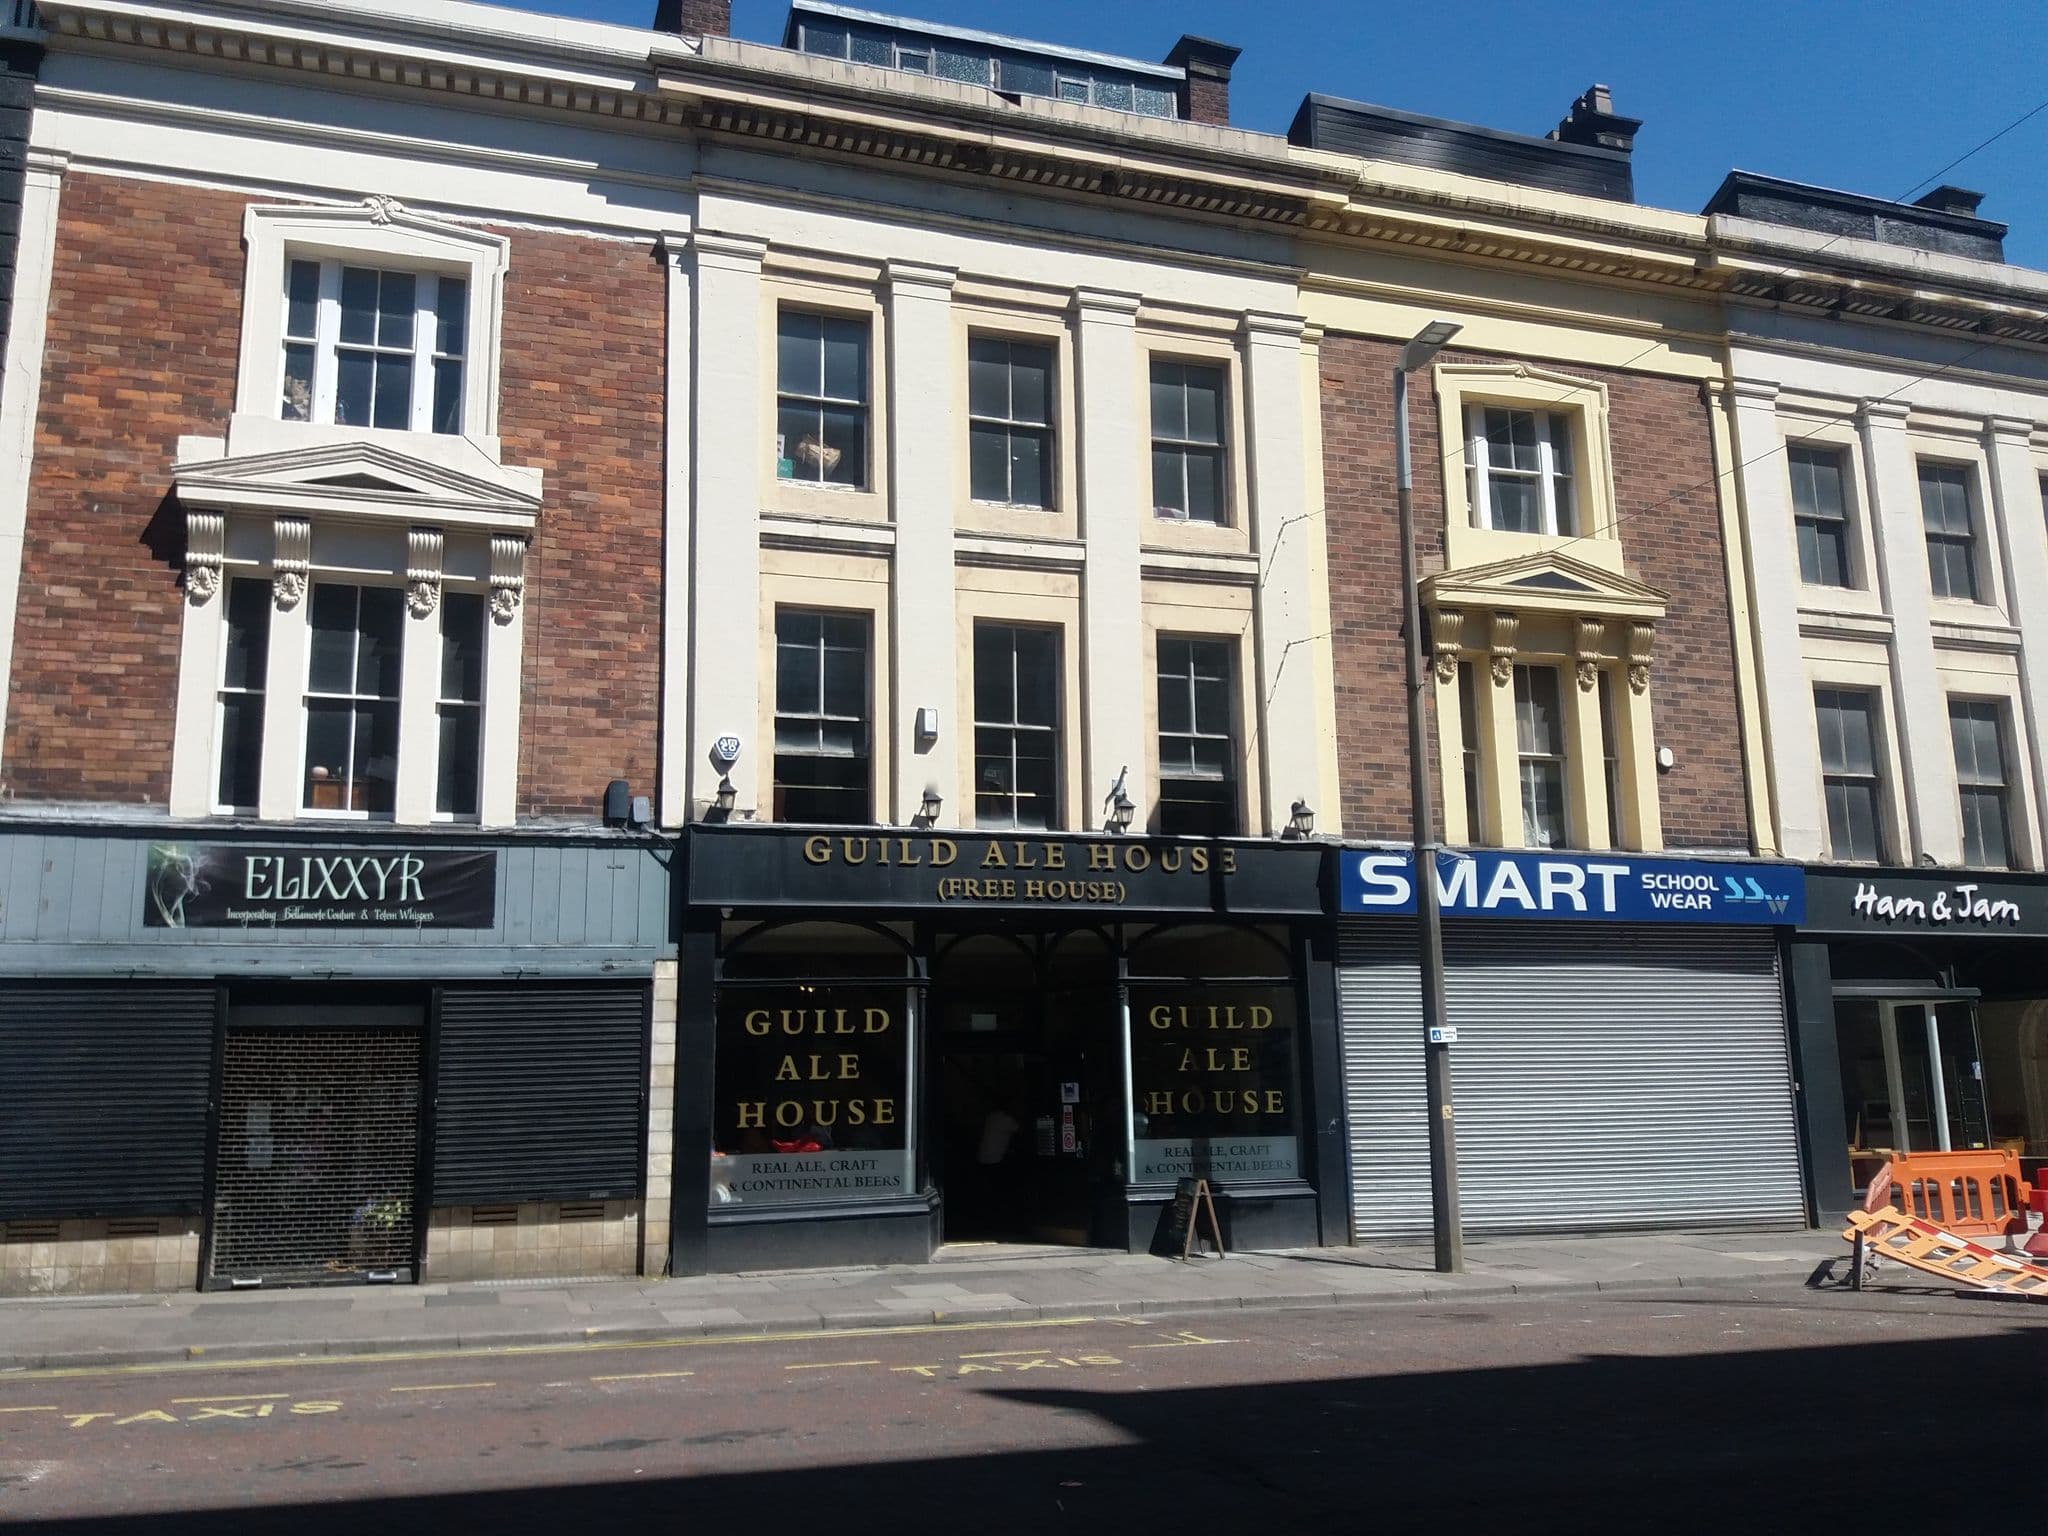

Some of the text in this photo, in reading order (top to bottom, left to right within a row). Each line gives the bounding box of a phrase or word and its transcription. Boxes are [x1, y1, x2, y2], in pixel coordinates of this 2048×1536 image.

[804, 835, 1238, 873] GUILD ALE HOUSE
[244, 852, 425, 901] ELIXXYR
[1359, 855, 1631, 912] SMART
[1641, 873, 1720, 891] SCHOOL
[938, 877, 1126, 904] (FREE HOUSE)
[1650, 892, 1712, 910] WEAR
[1854, 882, 2020, 922] Ham & Jam
[226, 907, 277, 929] Incorporating
[360, 909, 369, 921] &
[745, 1008, 890, 1035] GUILD
[1150, 1005, 1273, 1029] GUILD
[775, 1054, 860, 1081] ALE
[1178, 1048, 1251, 1072] ALE
[736, 1099, 895, 1129] HOUSE
[1148, 1090, 1285, 1115] HOUSE
[1230, 1144, 1272, 1156] CRAFT
[751, 1159, 878, 1174] REAL ALE, CRAFT
[1157, 1160, 1249, 1174] CONTENTAL
[1253, 1159, 1292, 1171] BEERS
[742, 1178, 850, 1191] CONTINENTAL
[855, 1176, 900, 1187] BEERS
[889, 1355, 1123, 1376] TAXIS
[62, 1400, 344, 1428] TAXIS
